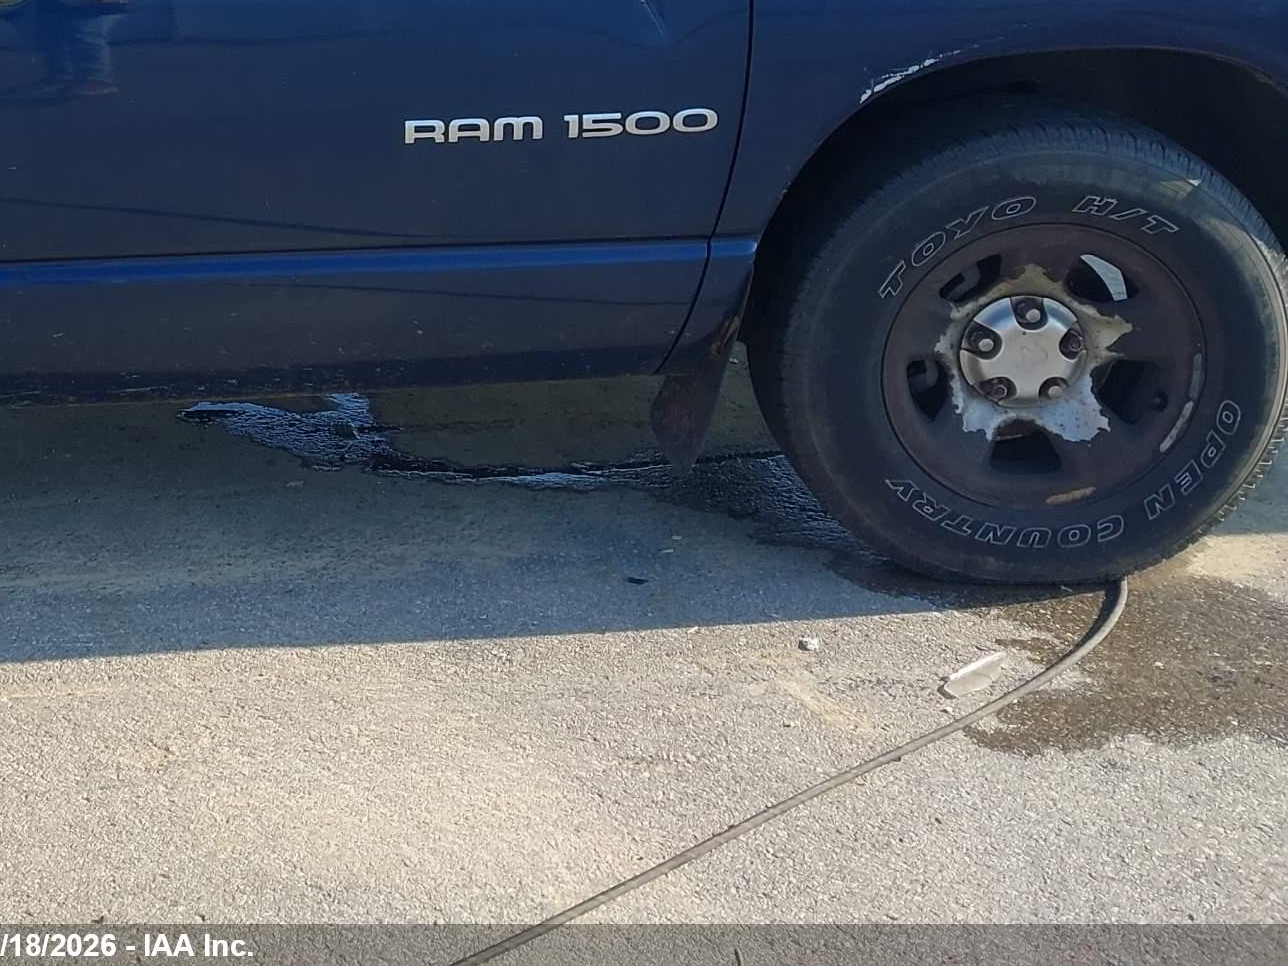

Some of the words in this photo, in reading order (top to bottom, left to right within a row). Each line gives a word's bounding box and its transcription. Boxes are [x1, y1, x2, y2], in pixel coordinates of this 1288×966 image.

[403, 115, 544, 145] RAM
[563, 107, 719, 139] 1500
[877, 196, 1037, 299] TOYO
[1071, 194, 1180, 235] H/T
[1142, 399, 1242, 521] OPEN
[884, 478, 1125, 548] COUNTRY
